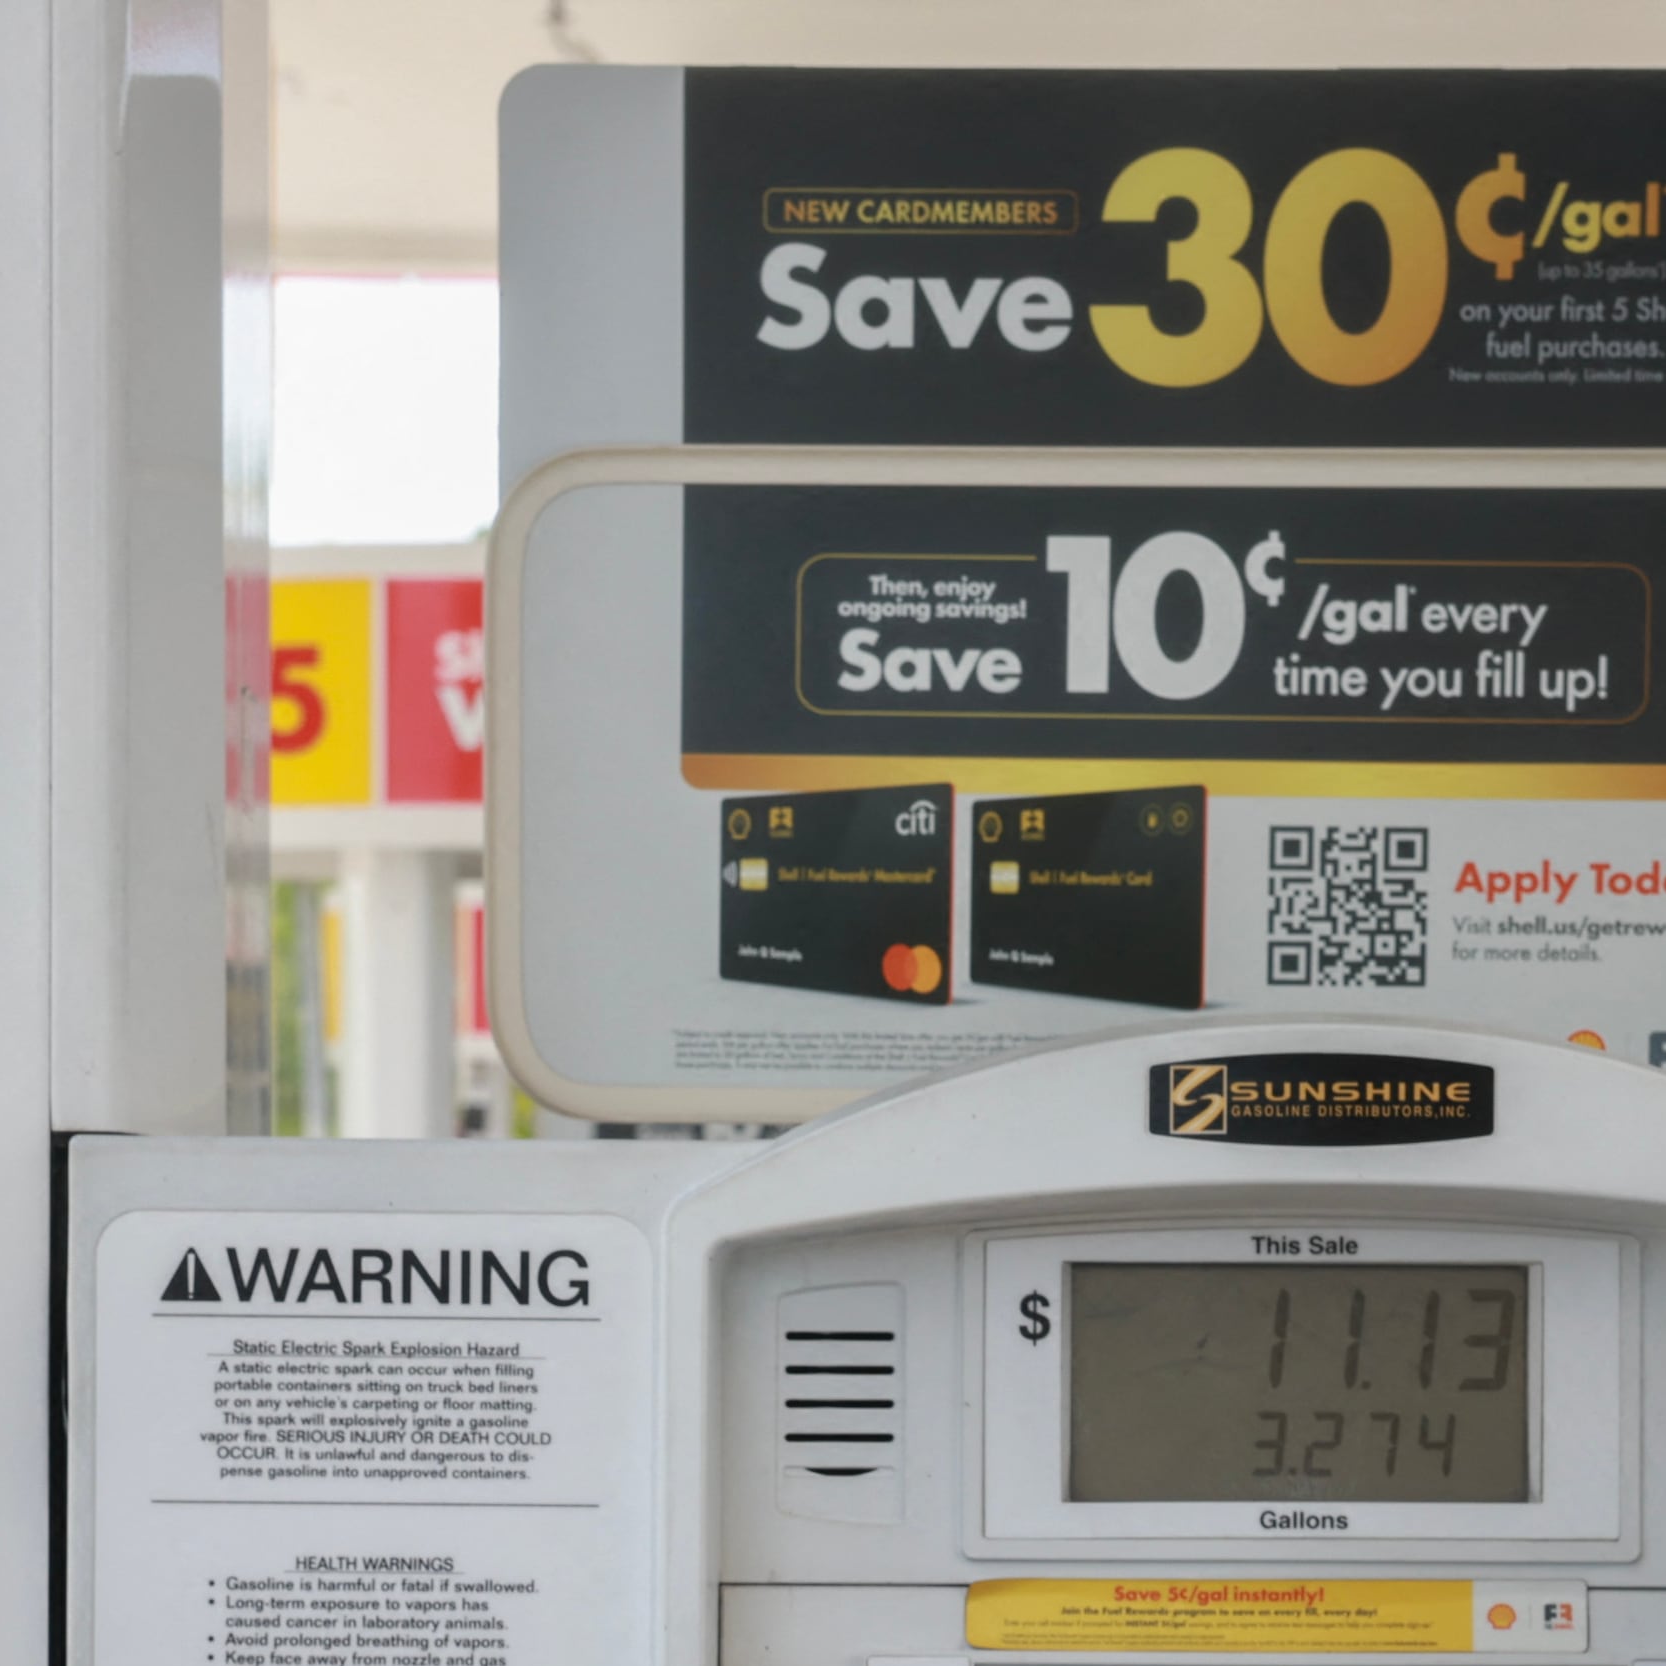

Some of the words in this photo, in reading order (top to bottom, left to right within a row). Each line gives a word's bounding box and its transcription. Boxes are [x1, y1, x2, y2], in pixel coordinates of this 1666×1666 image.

[783, 199, 849, 226] NEW
[856, 199, 1059, 226] CARDMEMBERS
[757, 242, 1074, 352] Save
[1458, 303, 1491, 322] on
[1497, 303, 1554, 328] your
[1559, 294, 1605, 322] first
[1611, 296, 1628, 322] 5
[1485, 330, 1531, 359] fuel
[1536, 331, 1664, 365] purchases.
[868, 575, 927, 601] Then,
[933, 577, 996, 604] enjoy
[837, 600, 928, 623] ongoing
[933, 598, 1028, 623] savings!
[837, 629, 1022, 695] Save
[1421, 602, 1548, 647] every
[1273, 653, 1368, 698] time
[1380, 666, 1463, 711] you
[1475, 649, 1526, 699] fill
[1539, 654, 1609, 713] up!
[894, 800, 937, 836] citi
[1453, 858, 1578, 904] Apply
[1453, 918, 1491, 934] Visit
[1451, 940, 1480, 962] for
[1484, 944, 1532, 962] more
[1539, 940, 1601, 962] details.
[1230, 1081, 1471, 1103] SUNSHINE
[1230, 1105, 1311, 1118] GASOLINE
[1250, 1235, 1302, 1257] This
[1307, 1235, 1359, 1257] Sale
[226, 1247, 591, 1308] WARNING
[1018, 1290, 1052, 1346] $
[233, 1340, 276, 1356] Static
[281, 1341, 337, 1356] Electric
[342, 1341, 386, 1359] Spark
[390, 1341, 462, 1360] Explosion
[466, 1342, 520, 1358] Hazard
[1267, 1288, 1515, 1392] 11.13
[1252, 1410, 1457, 1478] 3.274
[1258, 1509, 1348, 1530] Gallons
[295, 1556, 358, 1571] HEALTH
[362, 1557, 454, 1572] WARNINGS
[224, 1577, 295, 1591] Gasoline
[298, 1580, 312, 1592] is
[316, 1577, 376, 1592] harmful
[379, 1581, 396, 1592] or
[400, 1577, 434, 1592] fatal
[438, 1577, 449, 1592] if
[454, 1579, 540, 1593] swallowed.
[1113, 1585, 1162, 1603] Save
[1167, 1584, 1228, 1608] 5¢/gal
[1233, 1584, 1325, 1608] instantly!
